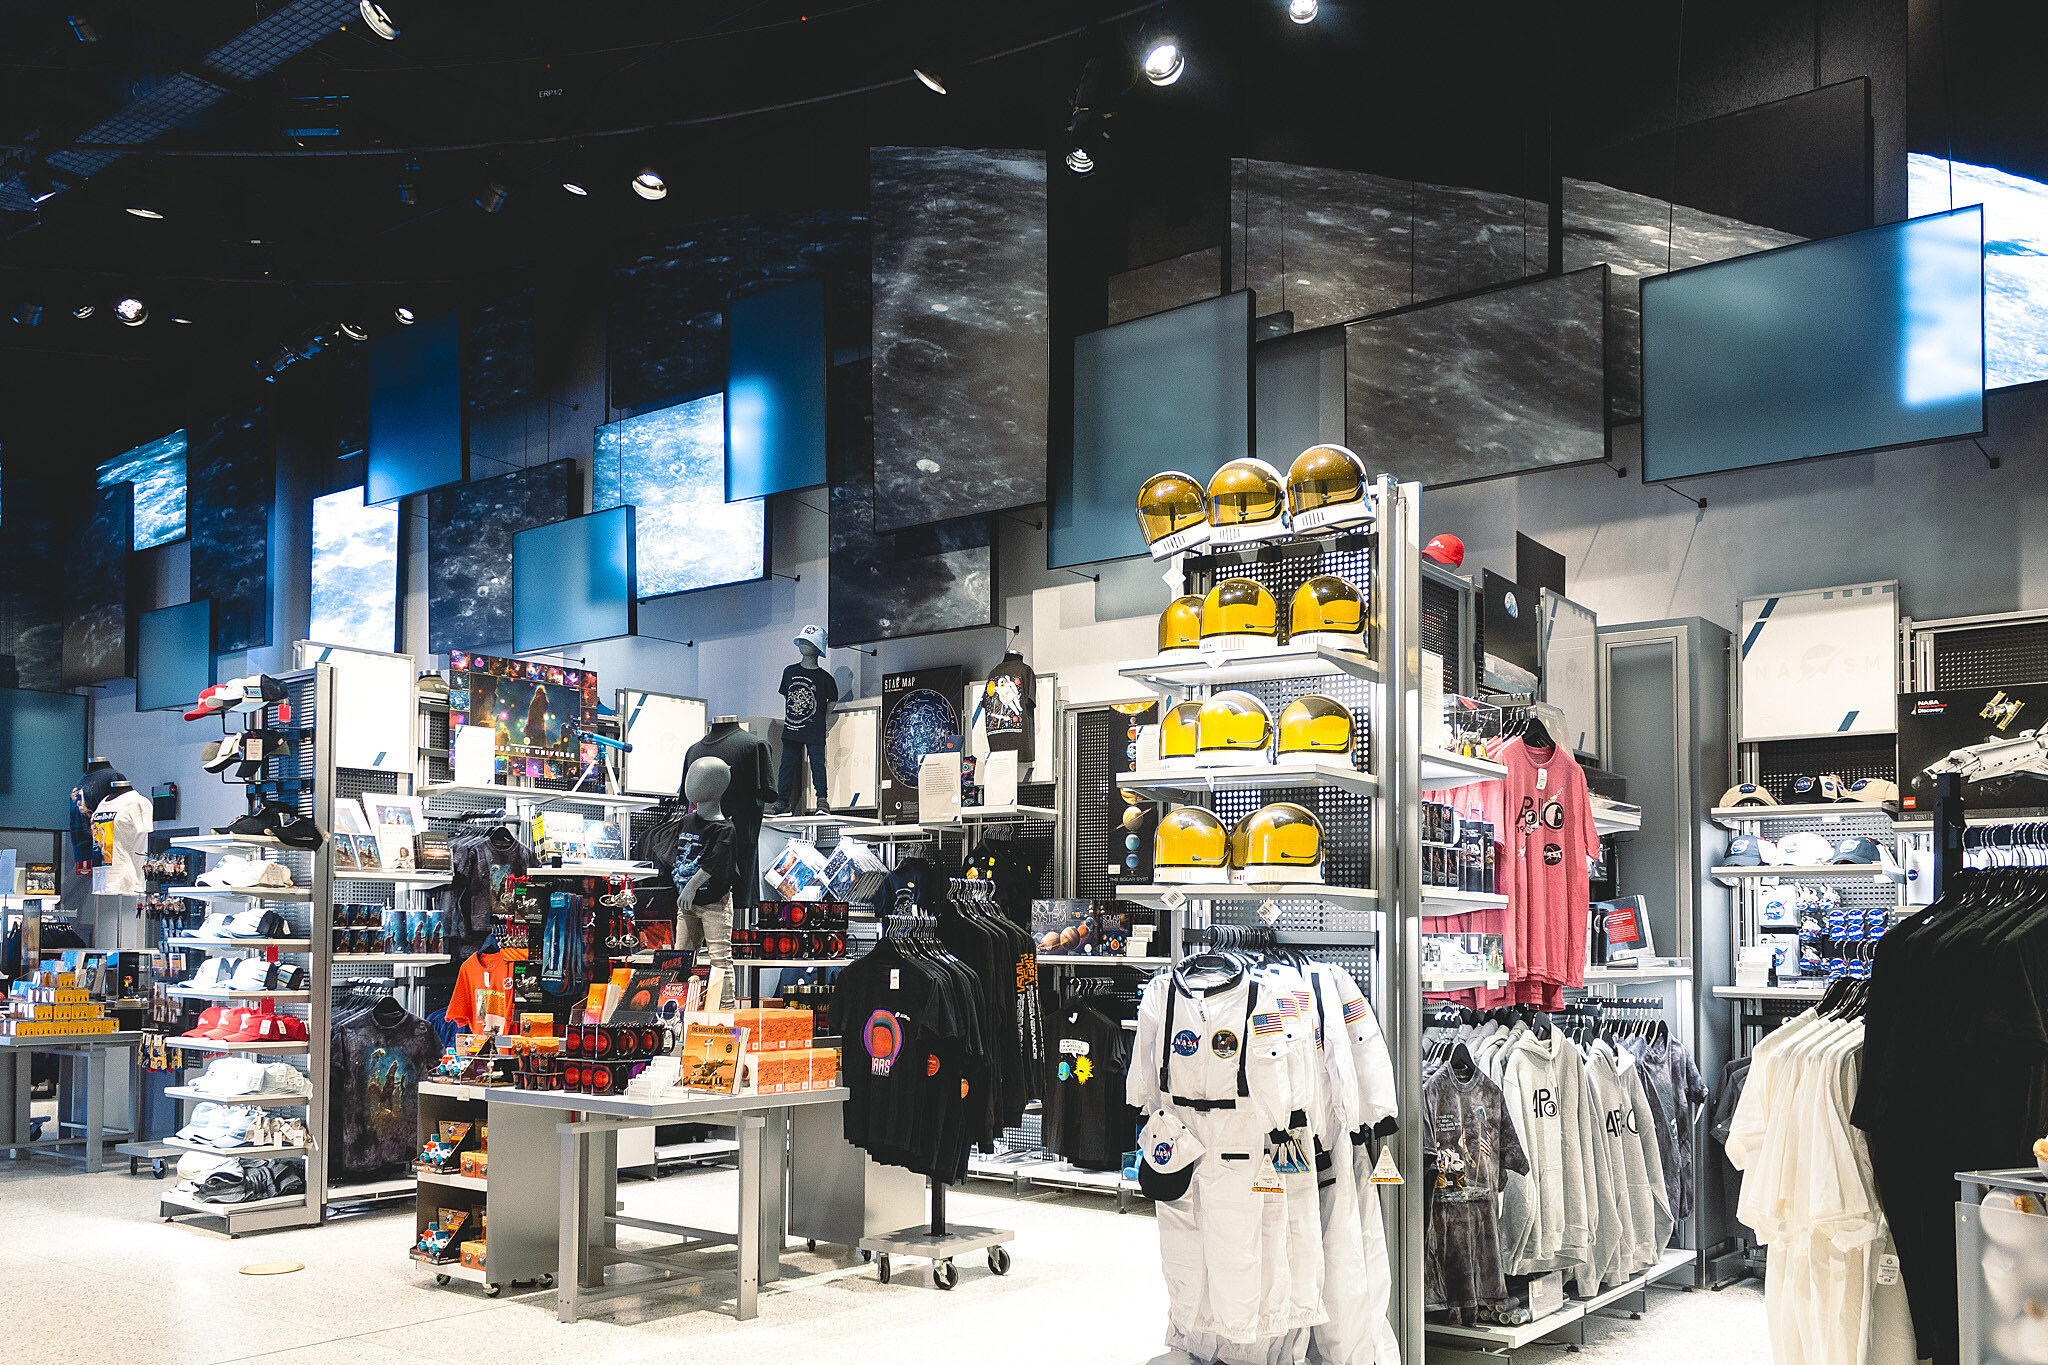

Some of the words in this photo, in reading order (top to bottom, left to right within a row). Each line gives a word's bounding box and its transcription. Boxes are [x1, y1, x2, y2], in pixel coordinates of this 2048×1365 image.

[902, 676, 916, 688] MAP
[535, 749, 575, 759] UNIVERSE
[1032, 900, 1067, 914] SOLAR
[1032, 913, 1067, 923] SYSTEM
[1103, 914, 1121, 922] SOLAR
[661, 956, 683, 970] MARS
[636, 975, 662, 988] MARS
[1026, 985, 1038, 1060] PERSEVERANCE
